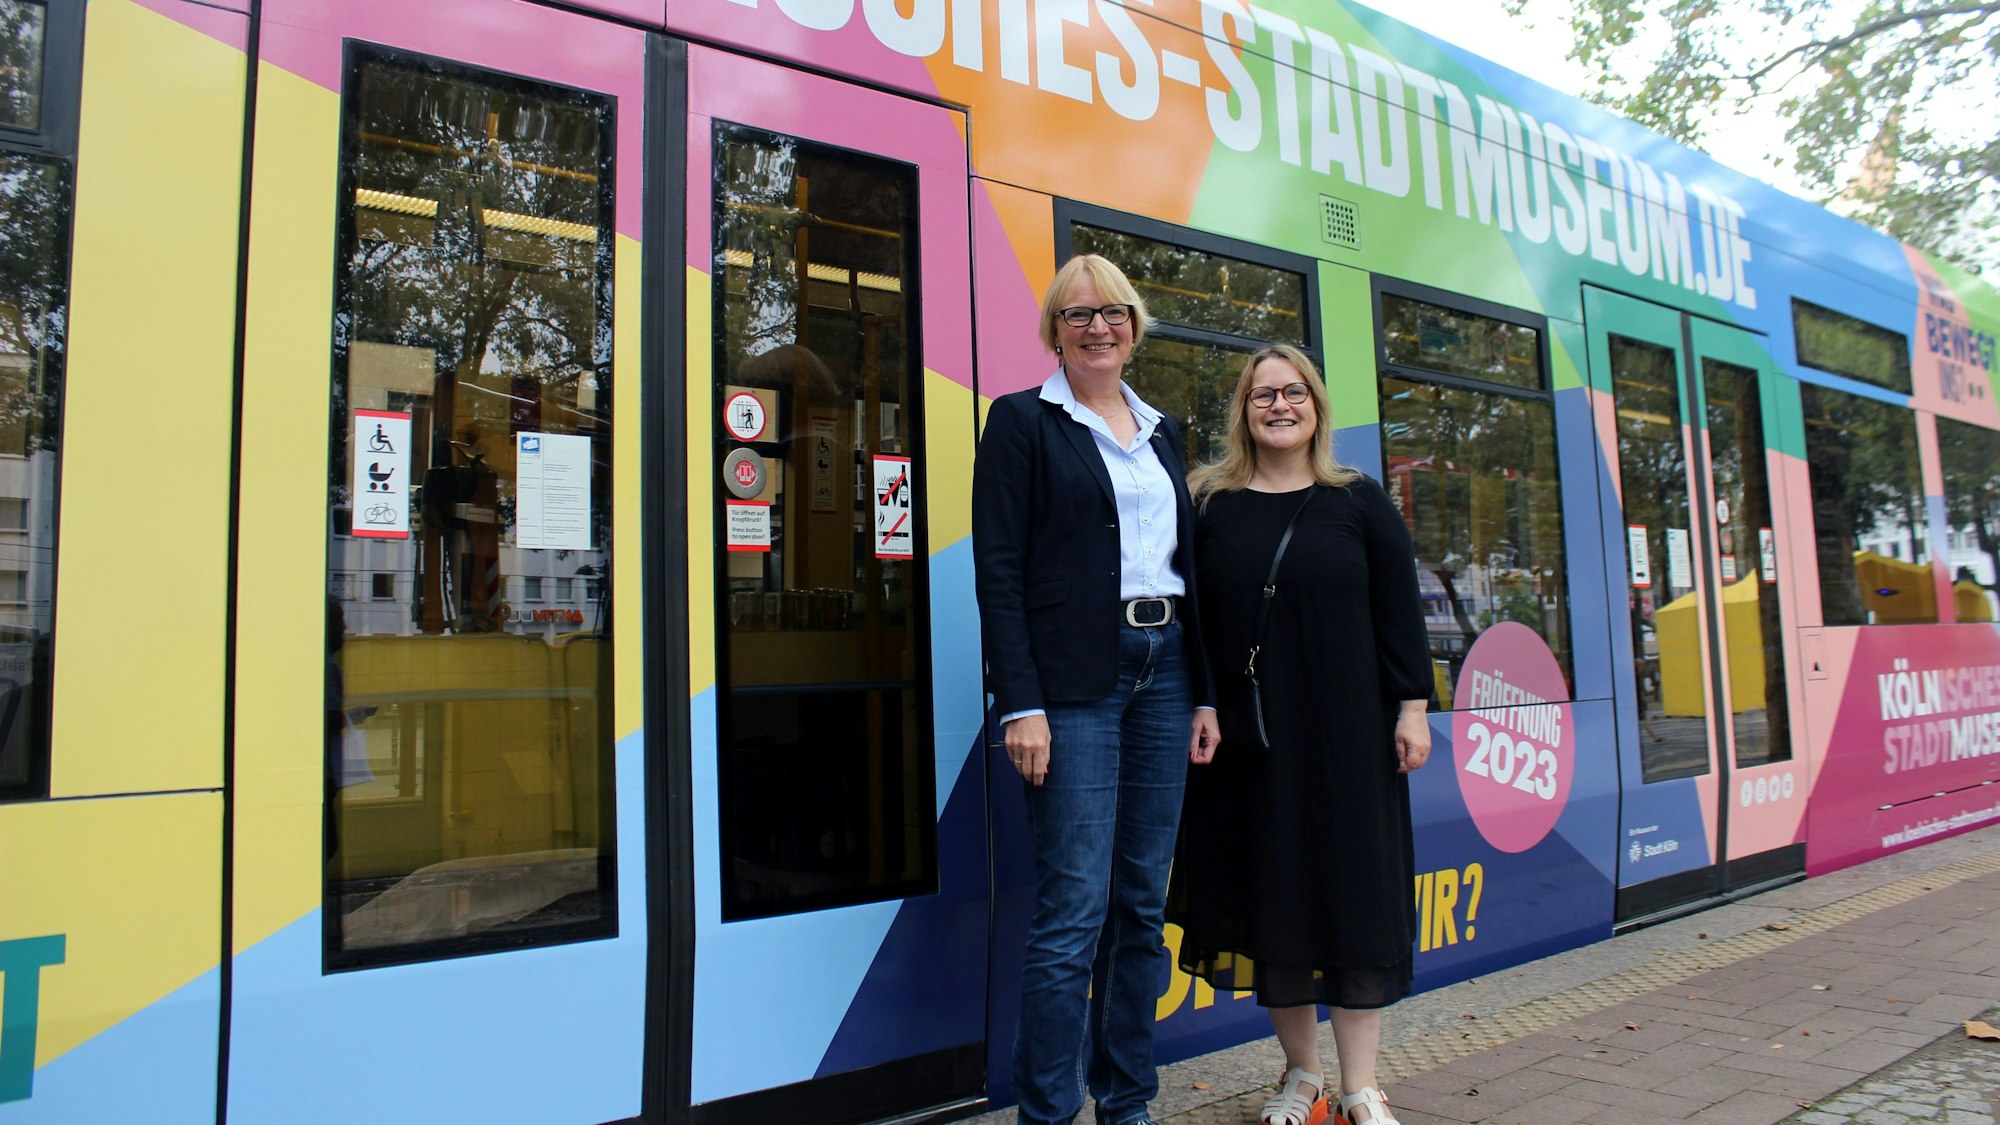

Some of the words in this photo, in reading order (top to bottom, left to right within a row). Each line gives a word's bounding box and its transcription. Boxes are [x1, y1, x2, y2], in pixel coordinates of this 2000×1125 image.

[727, 0, 1758, 310] ES-STADTMUSEUM.DE
[1469, 669, 1562, 748] ERÖFFNUNG
[1464, 722, 1558, 800] 2023
